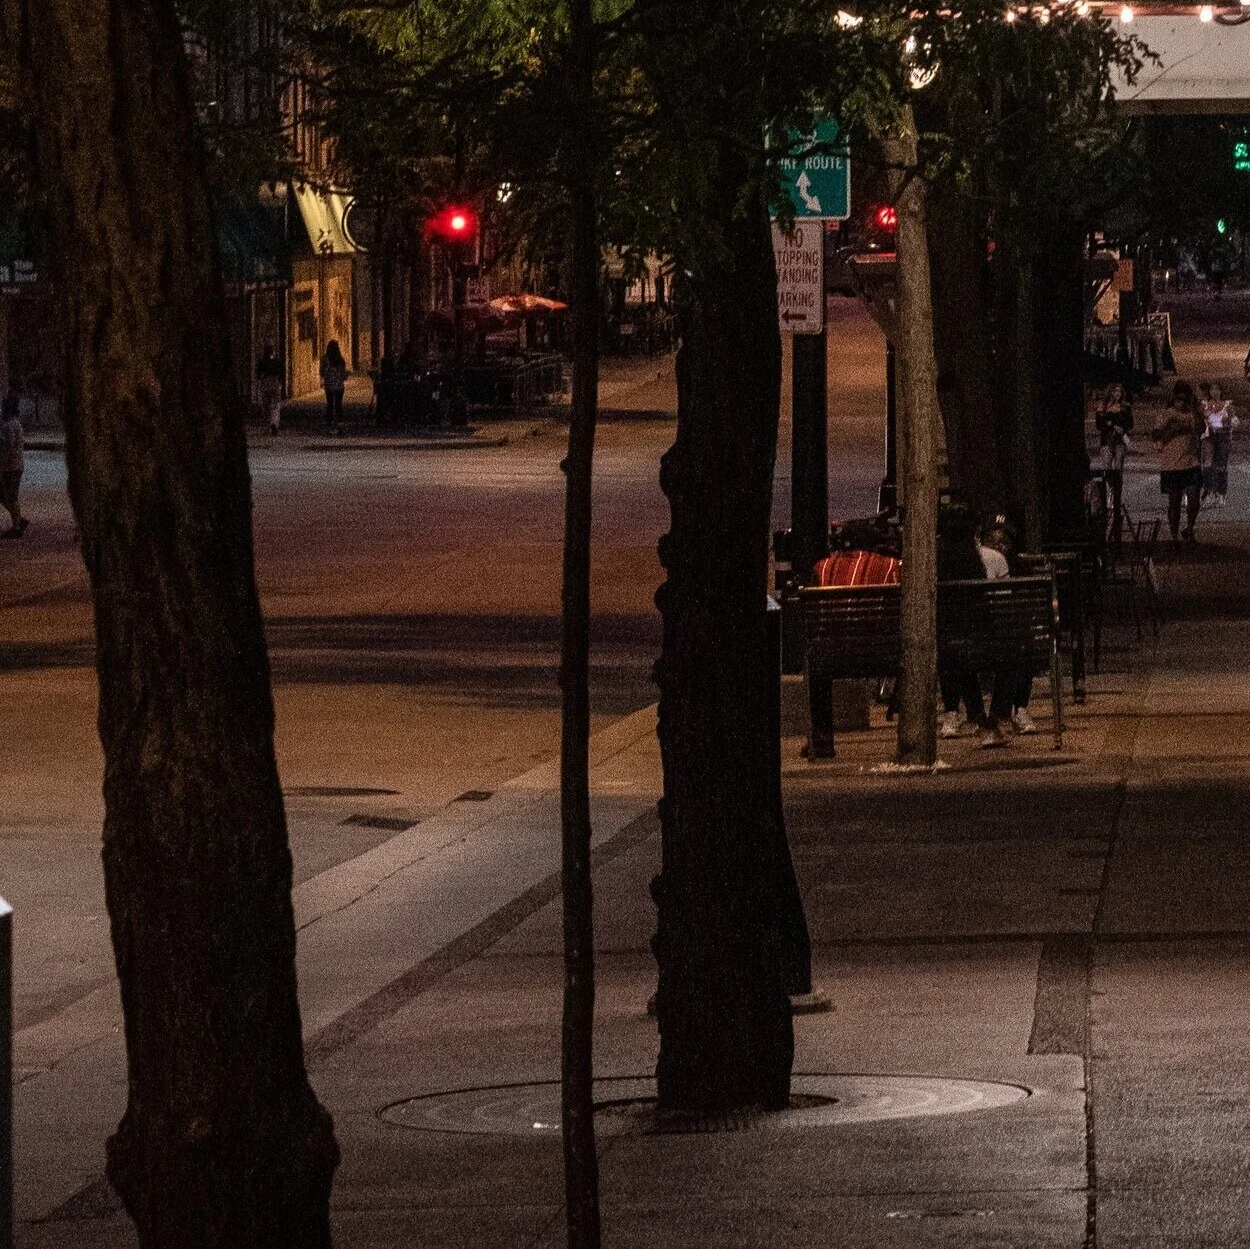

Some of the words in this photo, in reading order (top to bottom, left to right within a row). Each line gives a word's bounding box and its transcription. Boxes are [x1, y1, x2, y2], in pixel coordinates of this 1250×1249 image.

[805, 155, 842, 171] ROUTE
[777, 250, 819, 266] TOPPING
[776, 268, 818, 284] TANDING
[779, 291, 815, 307] ARKING
